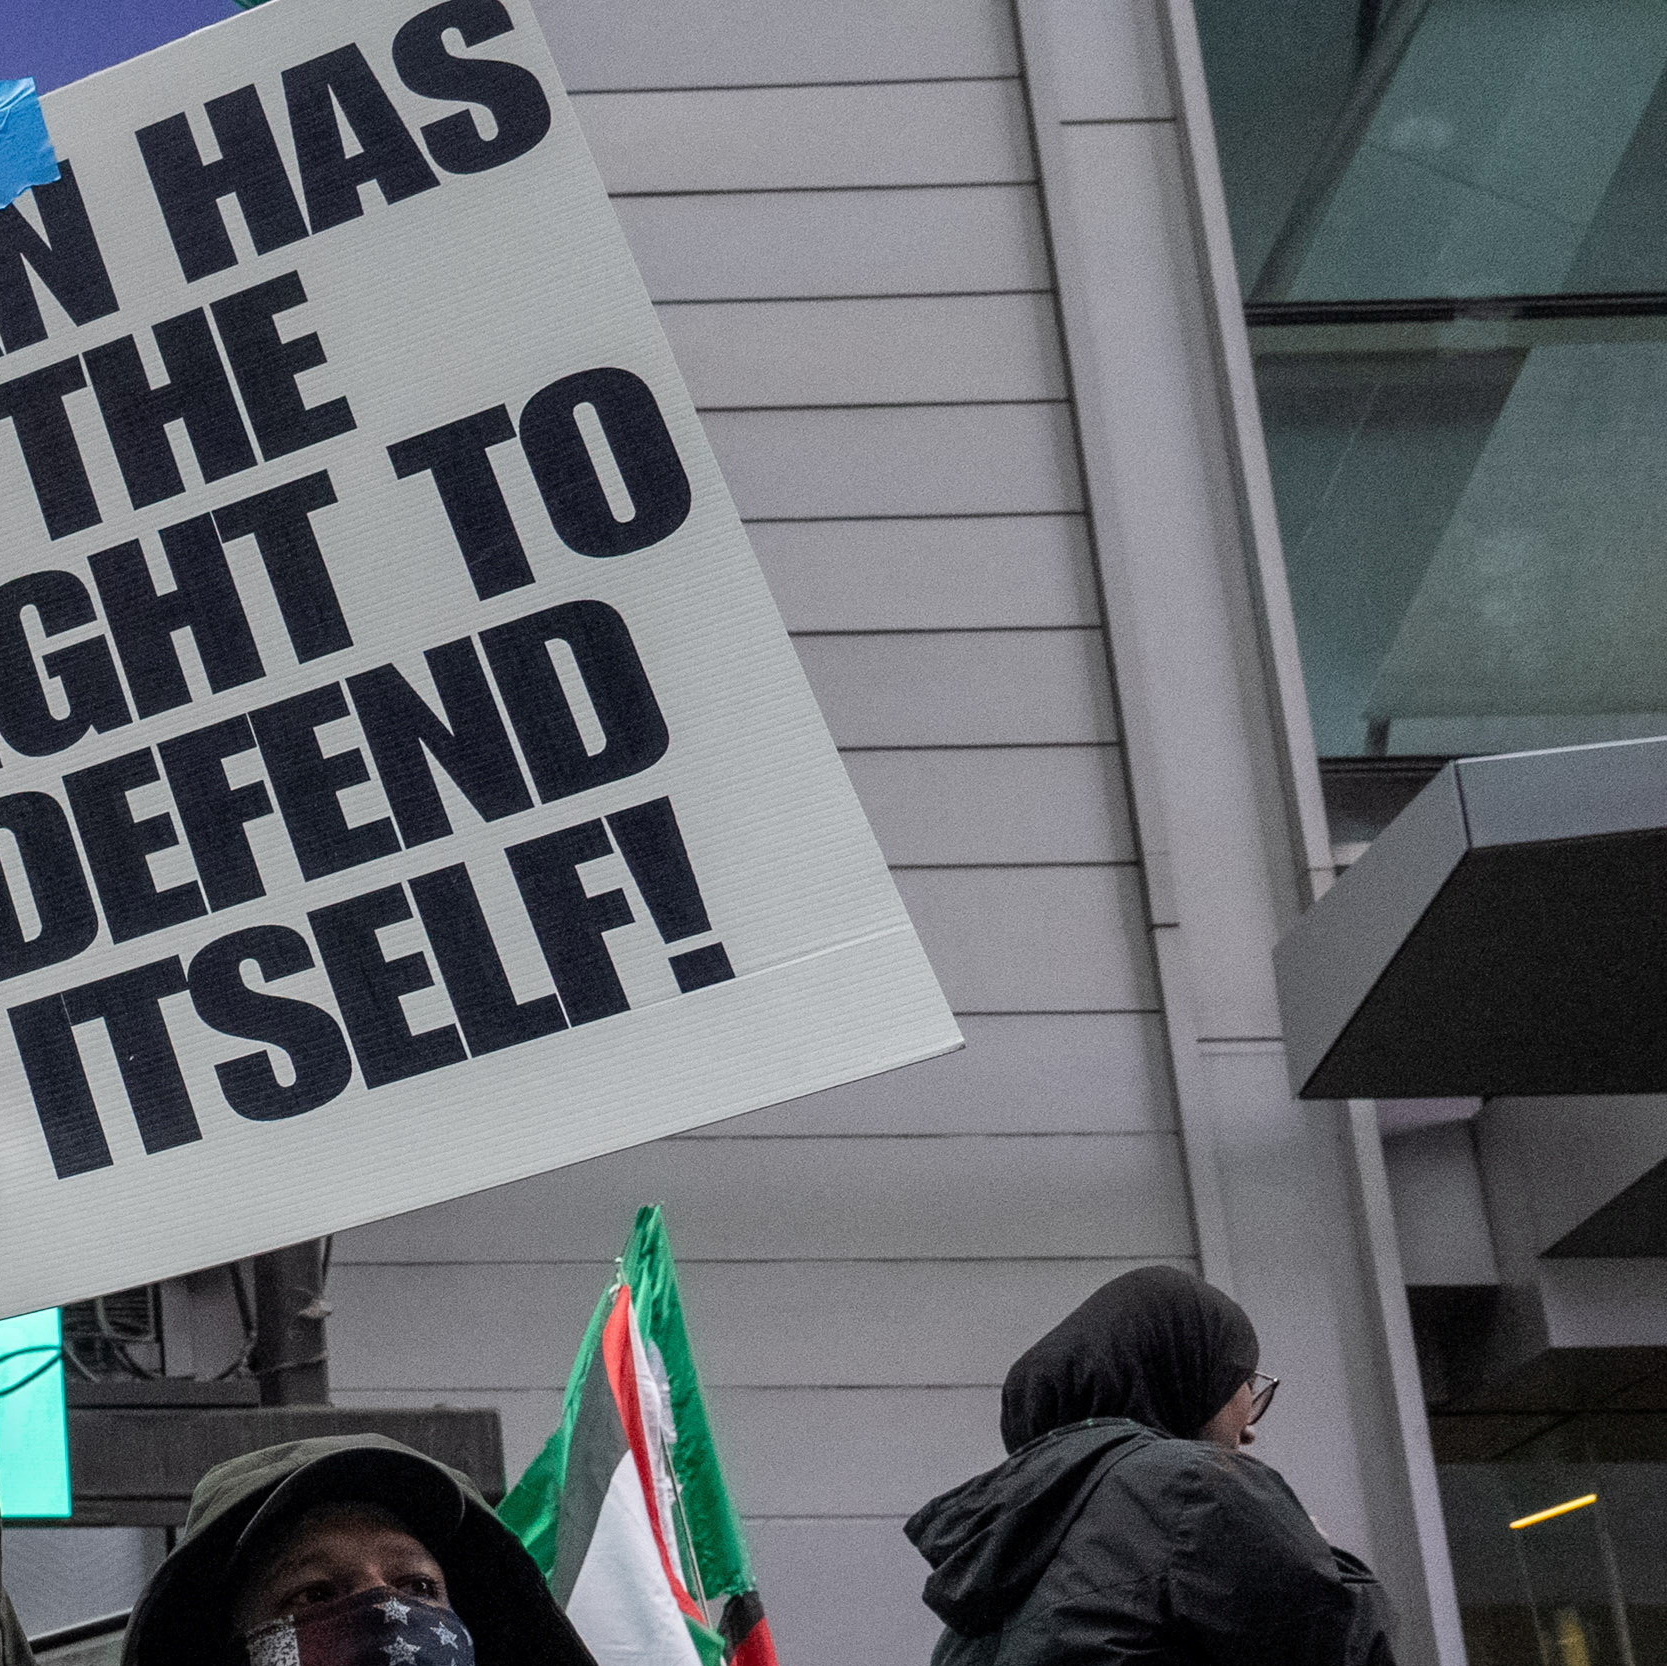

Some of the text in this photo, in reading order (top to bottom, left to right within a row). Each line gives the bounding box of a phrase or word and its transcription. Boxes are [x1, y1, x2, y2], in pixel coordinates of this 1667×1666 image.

[134, 0, 552, 284] HAS
[386, 366, 693, 600] TO
[7, 796, 736, 1180] ITSELF!
